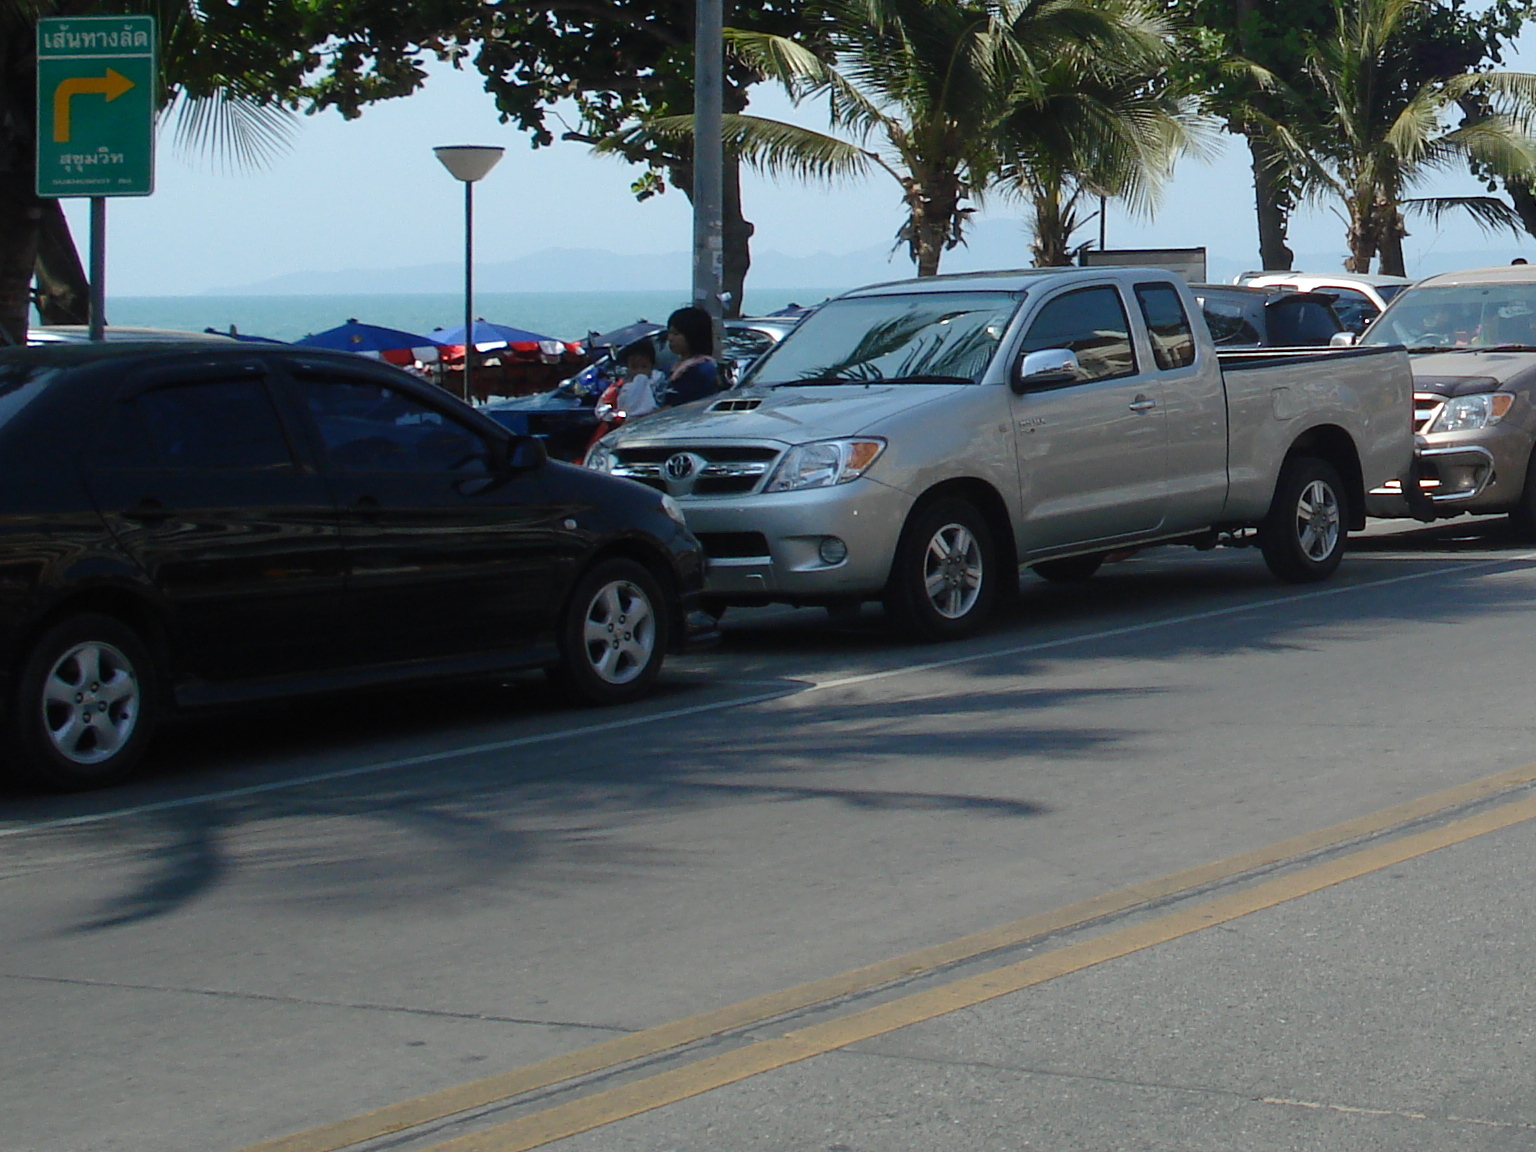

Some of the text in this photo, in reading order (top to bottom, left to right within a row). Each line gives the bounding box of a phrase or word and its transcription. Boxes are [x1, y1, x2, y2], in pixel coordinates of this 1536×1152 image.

[44, 24, 148, 48] เส้นทางลัด
[59, 146, 124, 173] สุขุมวิท
